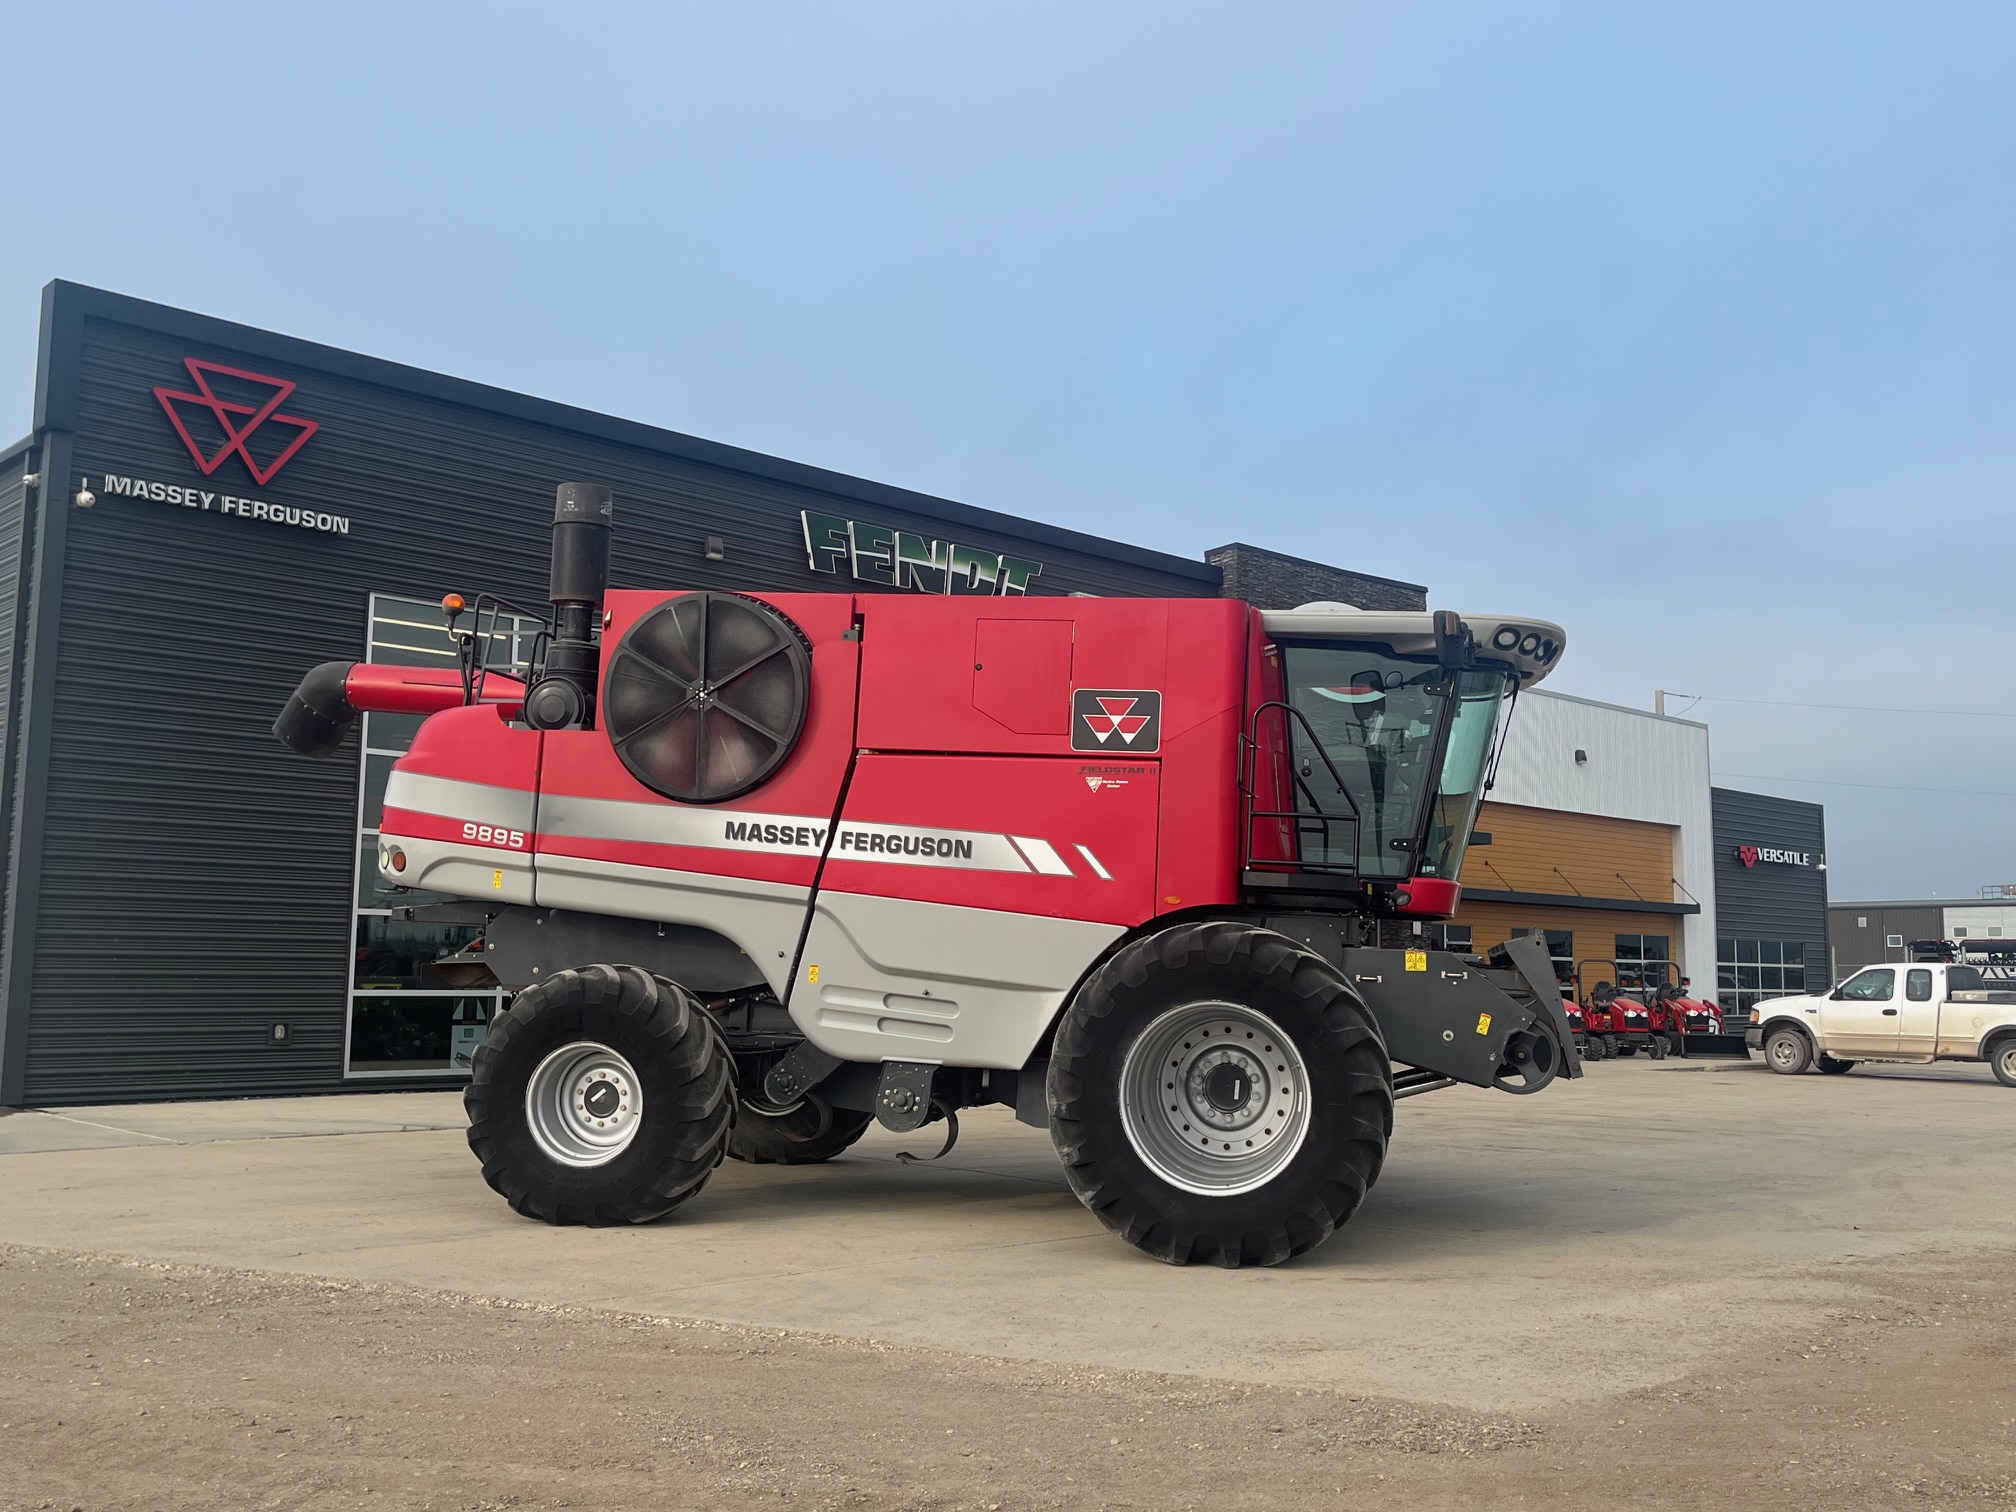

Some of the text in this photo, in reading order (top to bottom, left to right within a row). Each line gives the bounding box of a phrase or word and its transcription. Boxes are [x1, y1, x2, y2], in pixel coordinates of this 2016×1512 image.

[104, 474, 349, 534] MASSEY FERGUSON
[801, 510, 1043, 597] FENDT
[1080, 766, 1145, 775] FIELDSTAR
[462, 822, 524, 848] 9895
[725, 821, 972, 859] MASSEY FERGUSON
[1757, 847, 1809, 866] VERSATILE
